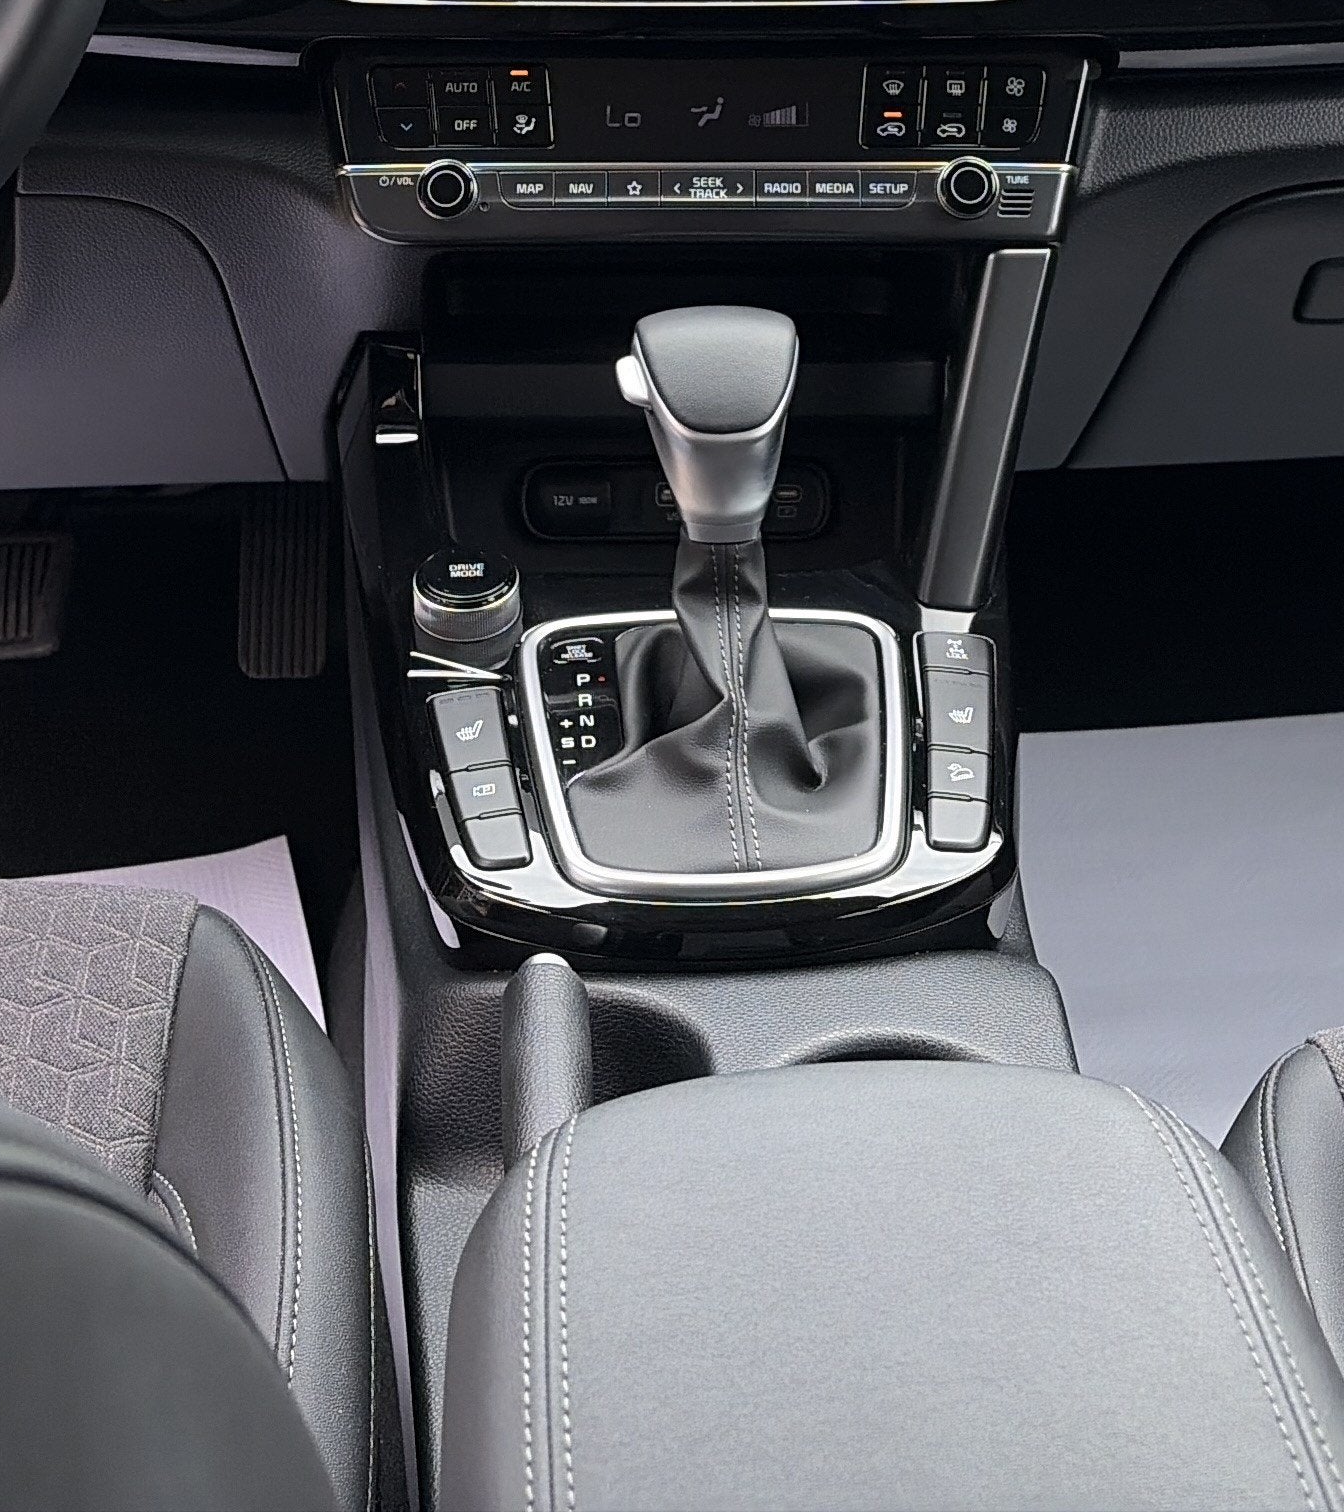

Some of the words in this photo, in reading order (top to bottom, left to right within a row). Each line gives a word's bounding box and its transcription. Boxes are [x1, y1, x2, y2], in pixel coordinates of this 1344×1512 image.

[445, 82, 478, 93] AUTO
[510, 81, 532, 92] A/C
[454, 119, 478, 131] OFF
[692, 176, 724, 188] SEEK
[1005, 175, 1030, 185] TUNE
[516, 183, 544, 195] MAP
[568, 182, 594, 194] NAV
[688, 188, 729, 199] TRACK
[763, 182, 802, 194] RADIO
[815, 182, 855, 194] MEDIA
[868, 182, 909, 195] SETUP
[553, 495, 574, 507] 12V
[448, 562, 485, 572] DRIVE
[449, 569, 484, 578] MODE
[576, 673, 591, 687] P
[577, 693, 593, 707] R
[579, 714, 595, 727] N
[560, 736, 575, 749] S
[580, 735, 597, 749] D
